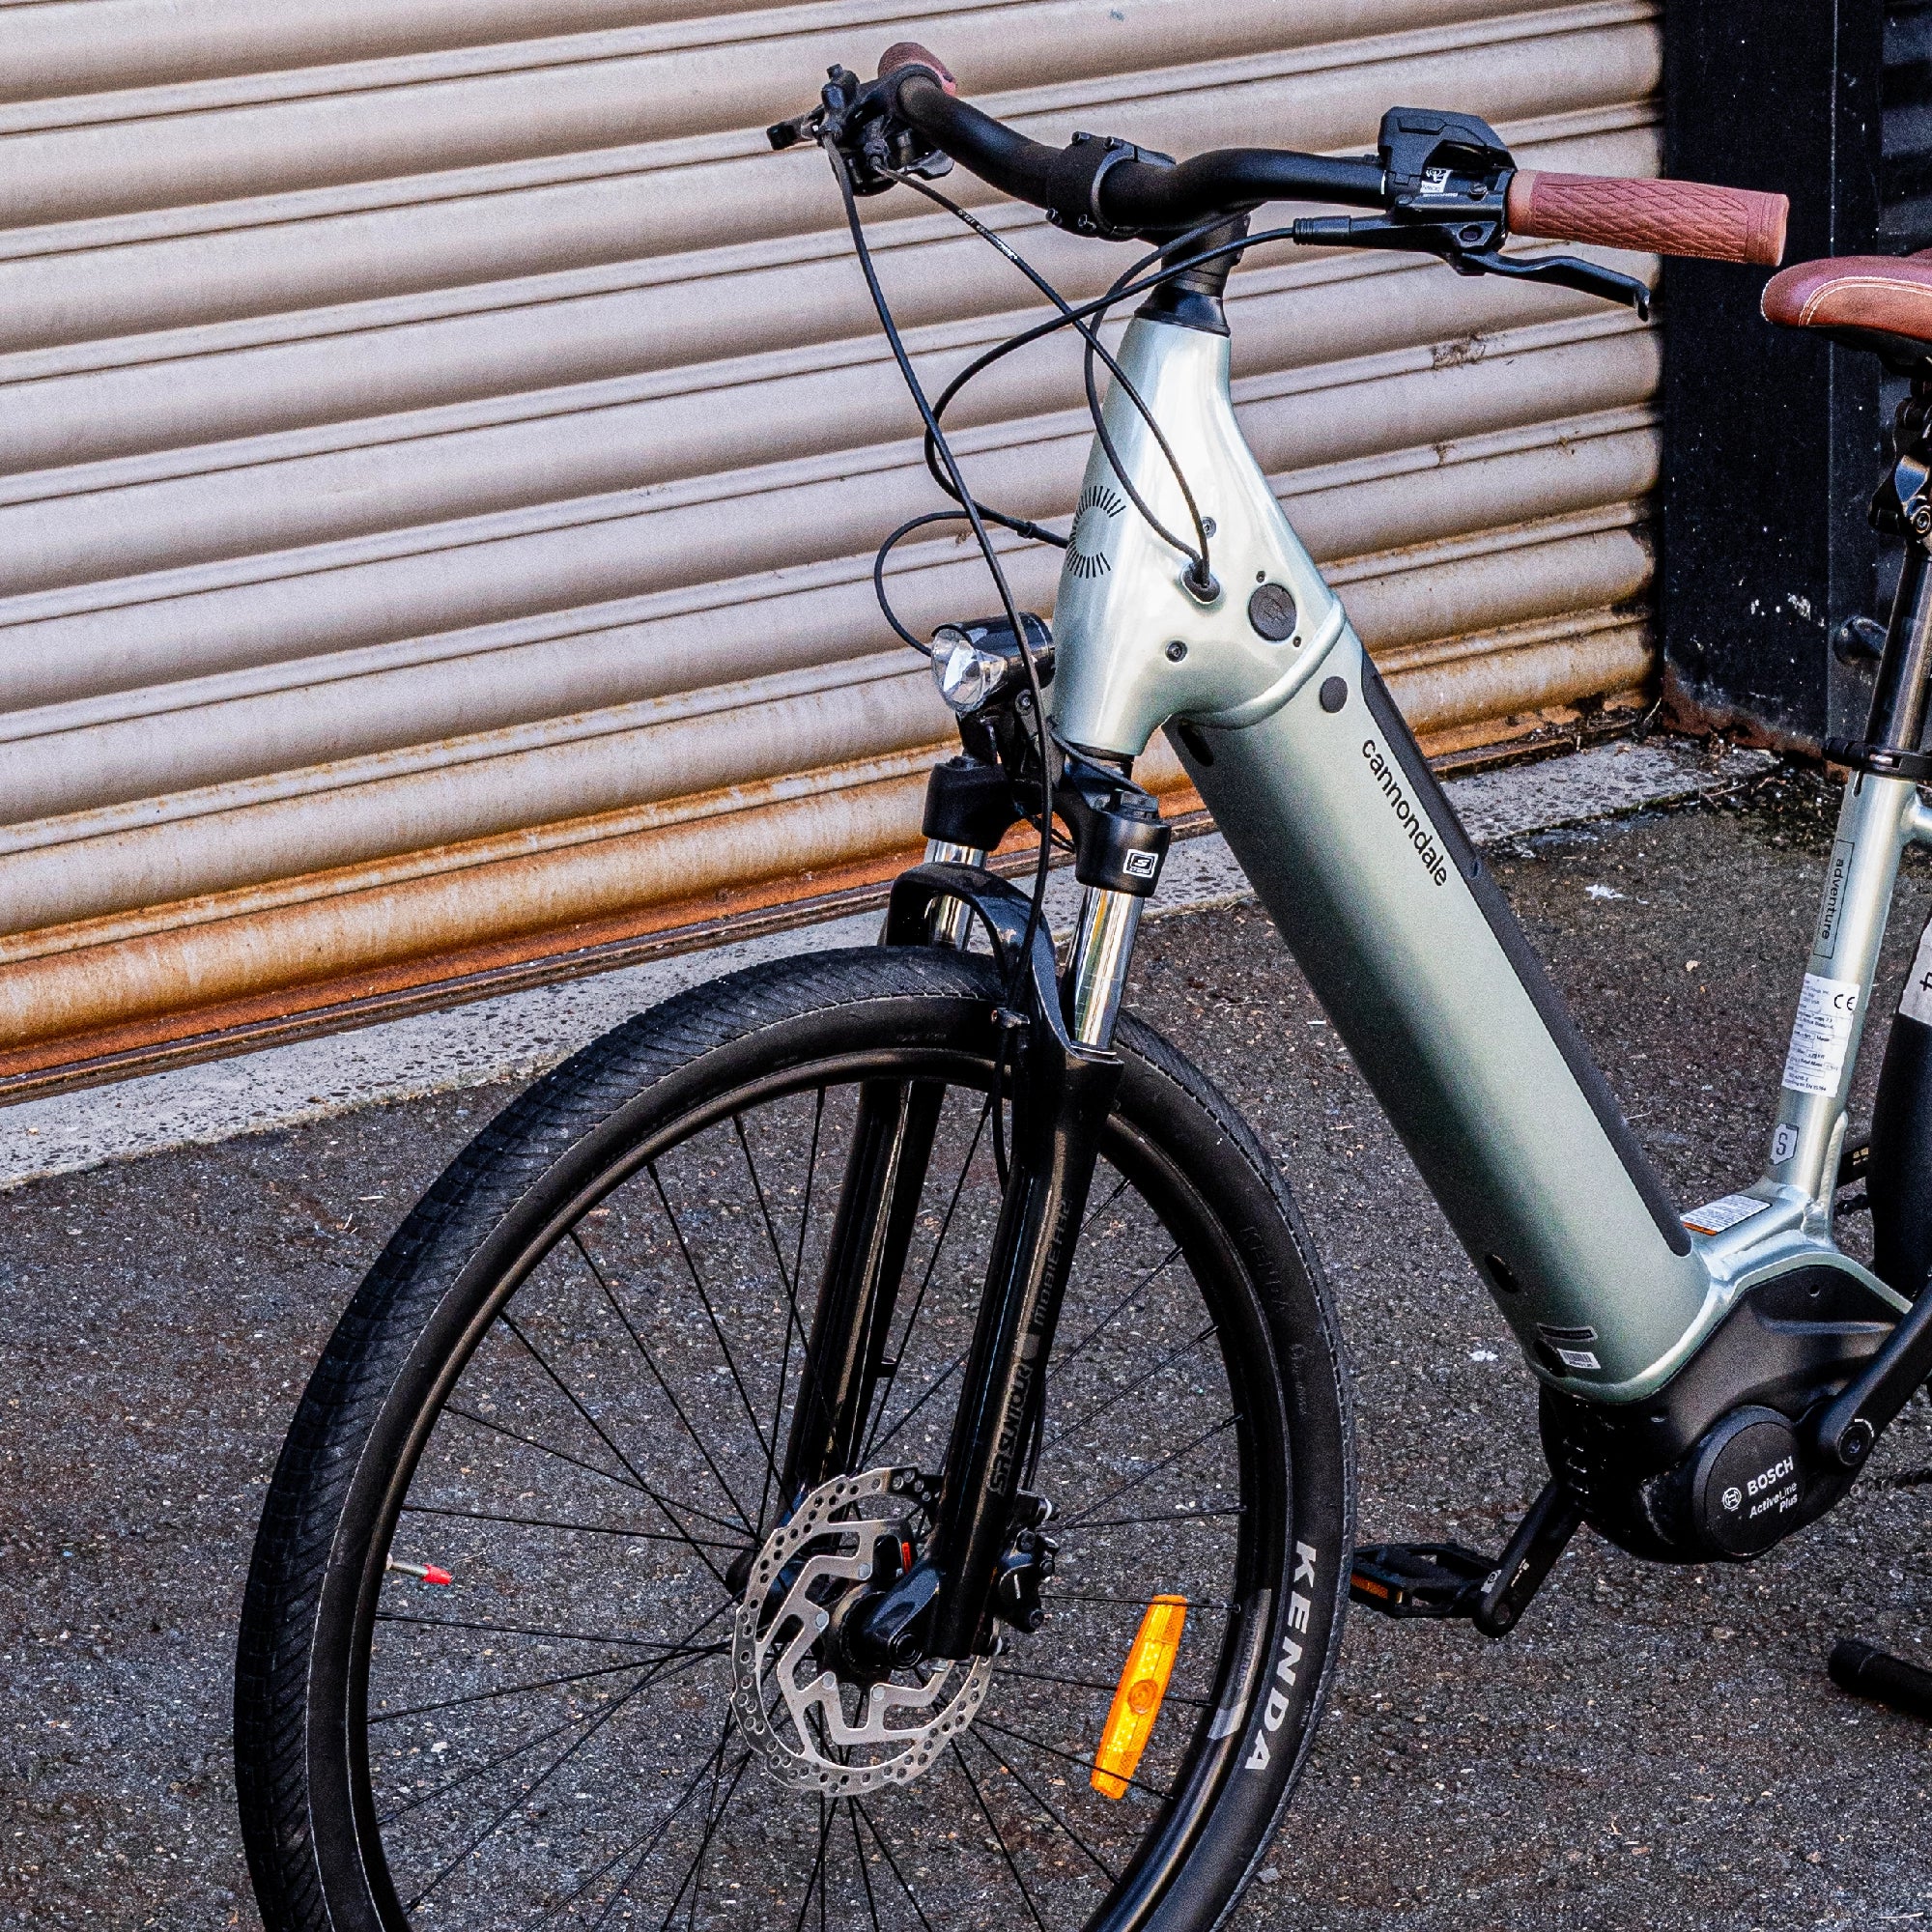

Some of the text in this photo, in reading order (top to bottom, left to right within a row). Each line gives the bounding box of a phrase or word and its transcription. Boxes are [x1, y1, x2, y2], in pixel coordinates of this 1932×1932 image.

[1362, 739, 1447, 887] cannondale
[1822, 858, 1844, 940] adventure
[1776, 1131, 1788, 1155] S
[1747, 1455, 1794, 1496] BOSCH
[1779, 1493, 1798, 1513] Plus
[1245, 1540, 1317, 1770] KENDA
